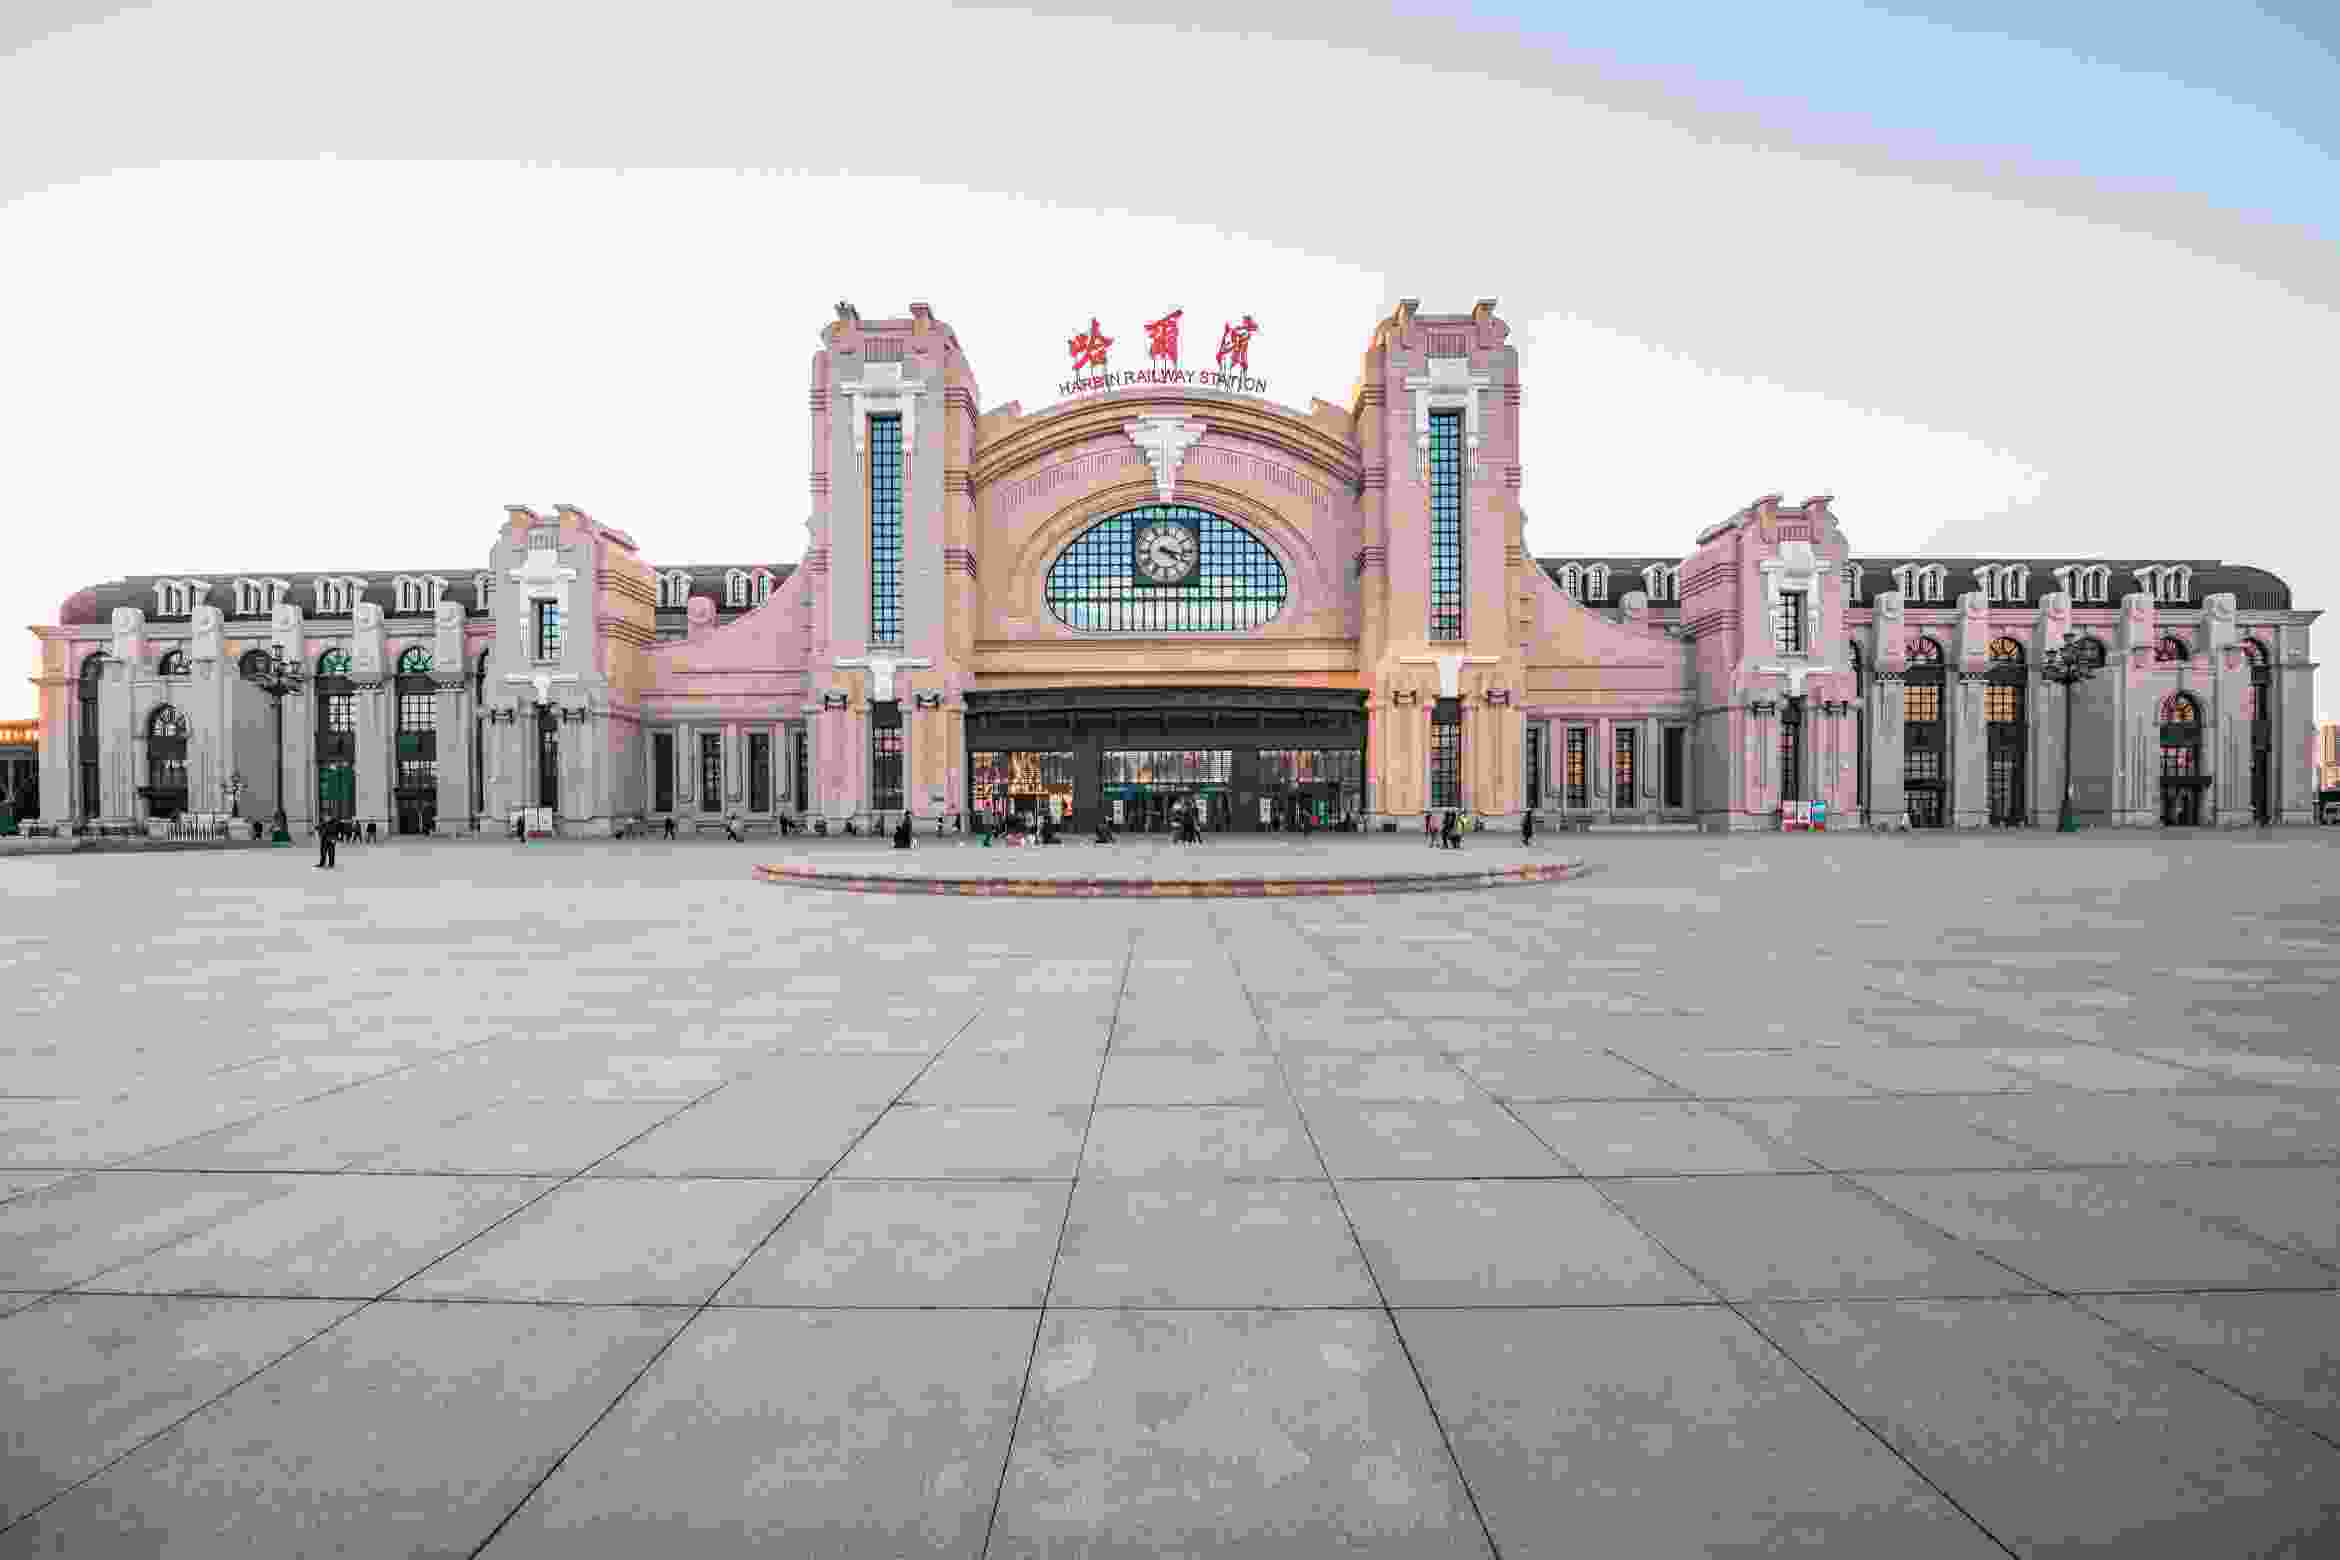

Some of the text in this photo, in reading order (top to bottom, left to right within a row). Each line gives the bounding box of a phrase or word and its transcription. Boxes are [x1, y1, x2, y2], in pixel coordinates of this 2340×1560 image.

[1058, 369, 1266, 393] HARBIN RAILWAY STATION
